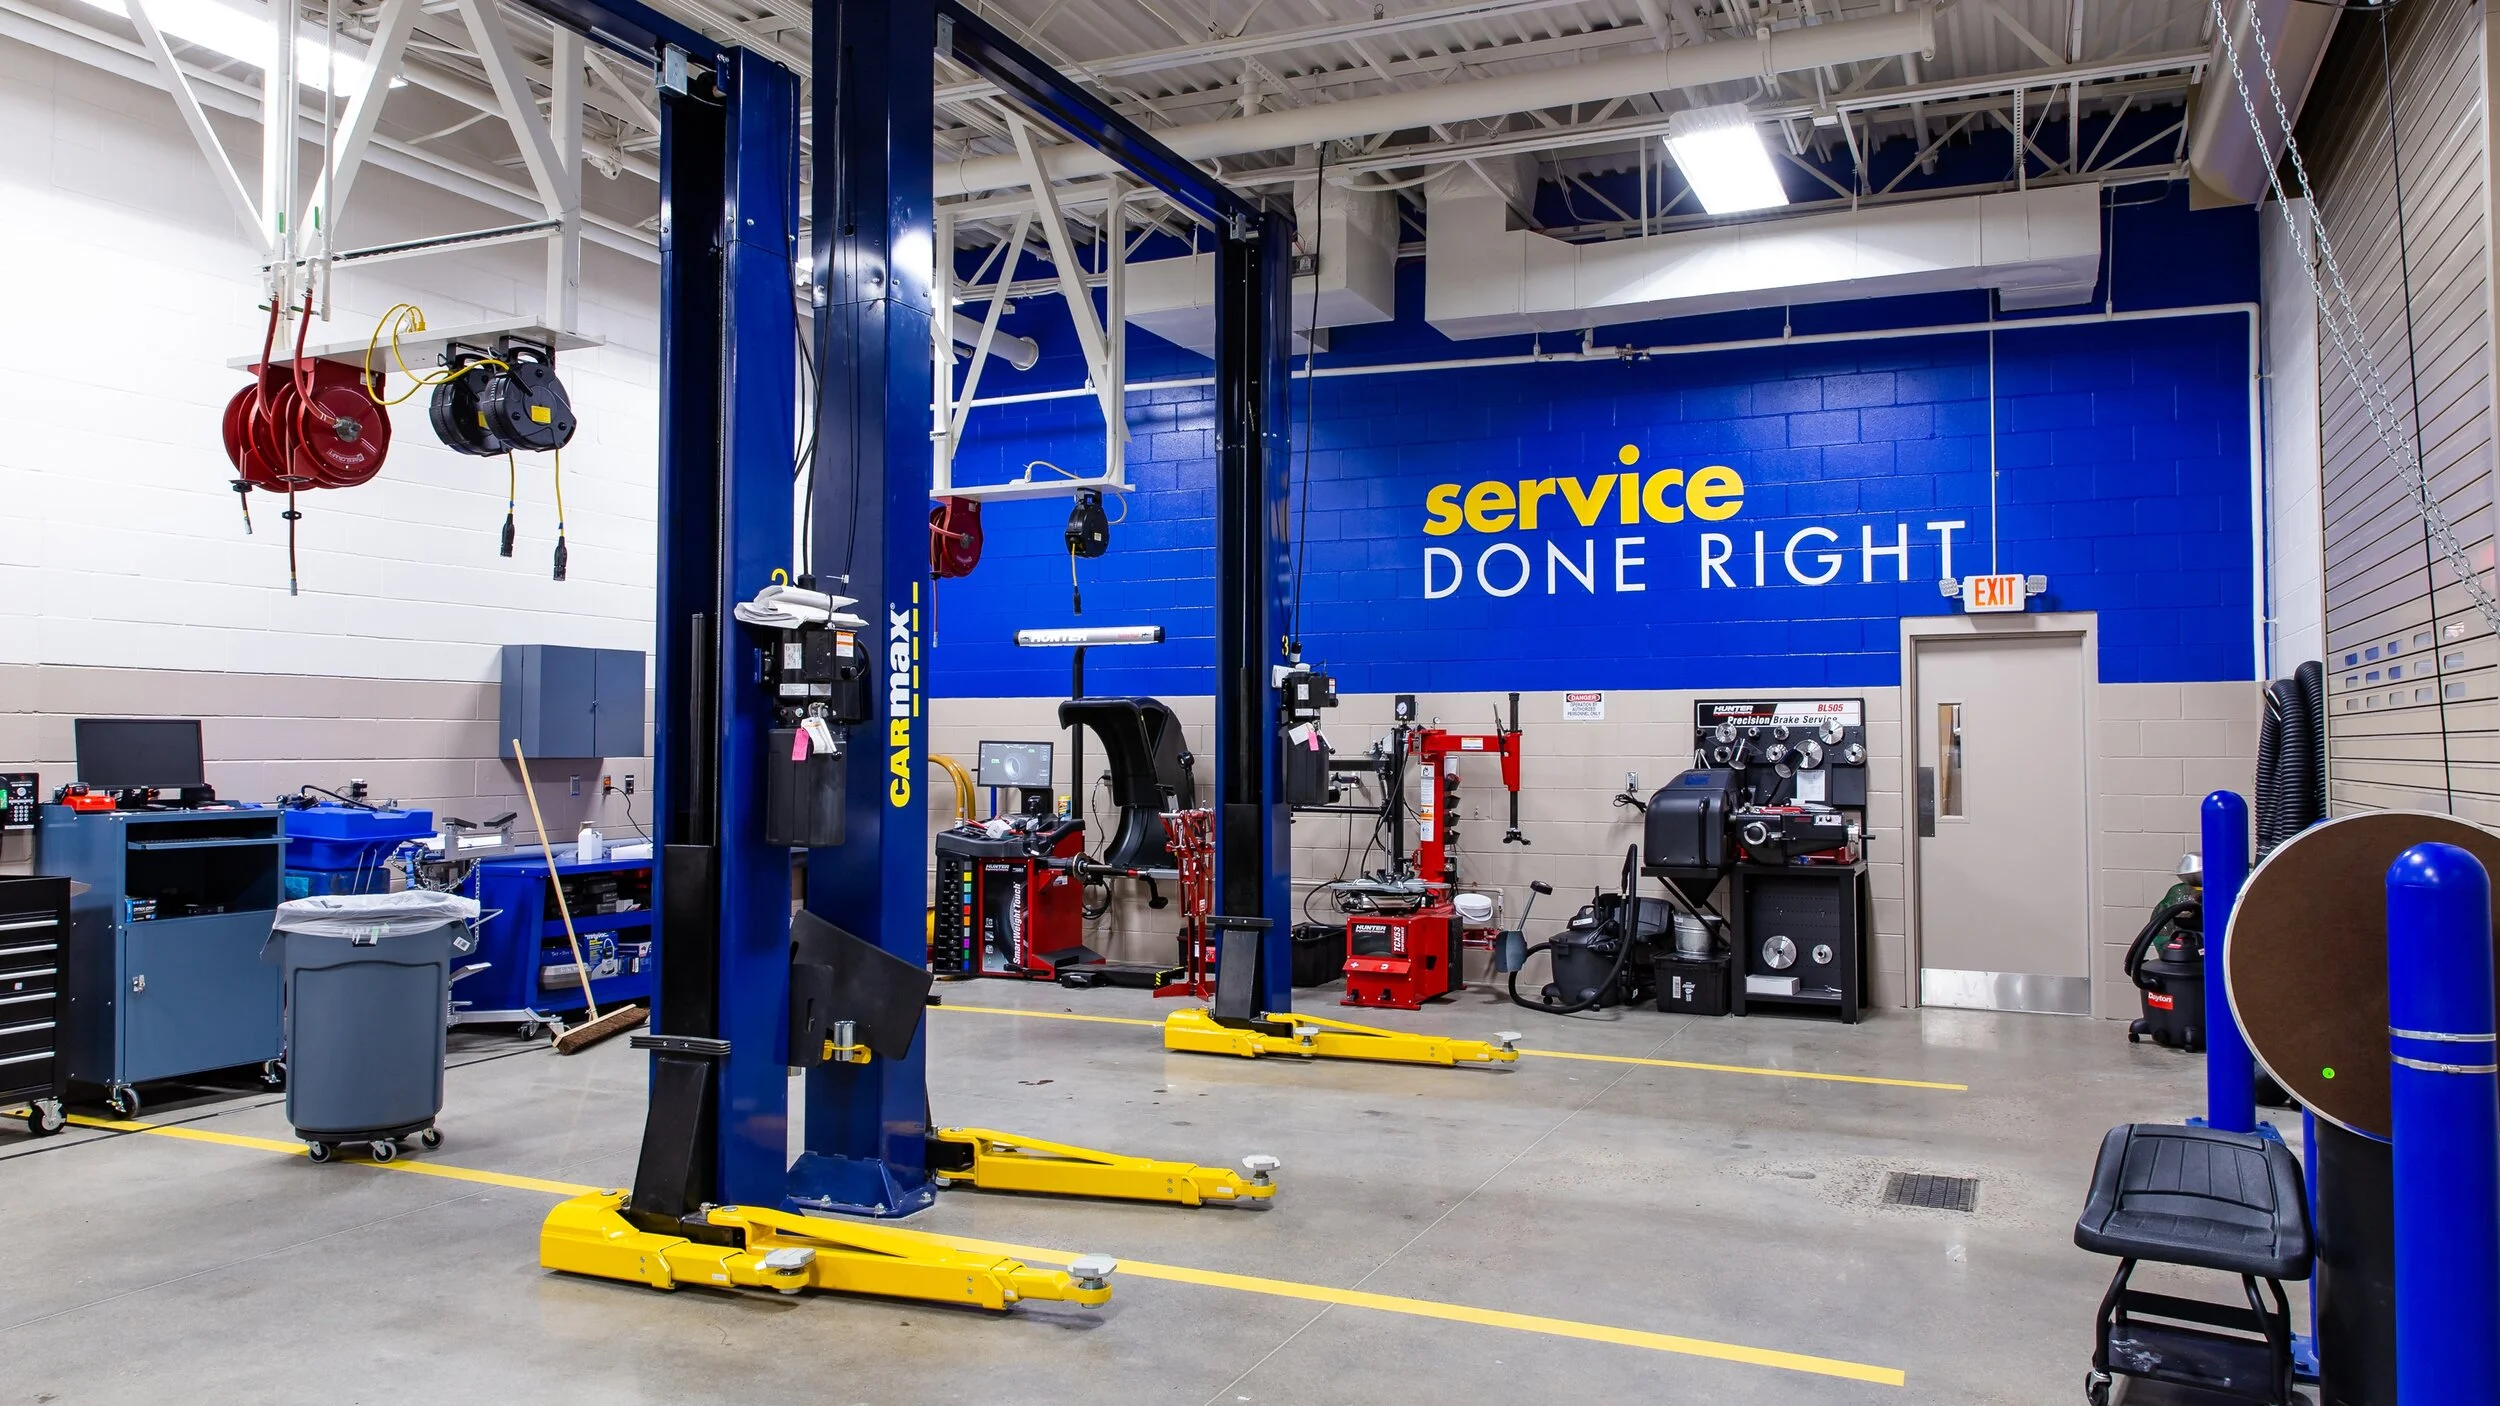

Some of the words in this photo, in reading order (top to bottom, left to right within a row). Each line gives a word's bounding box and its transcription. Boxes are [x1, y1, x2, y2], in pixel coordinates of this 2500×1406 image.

[1423, 444, 1745, 535] service
[1425, 537, 1646, 599] DONE
[1701, 520, 1966, 589] RIGHT
[1975, 577, 2016, 606] EXIT
[1282, 634, 1289, 656] 3
[889, 609, 911, 808] CARmax
[1727, 715, 1770, 725] Precision
[1773, 715, 1800, 724] Brake
[1817, 704, 1844, 712] BL505
[1013, 883, 1021, 908] Touch
[1013, 909, 1022, 965] SmartWeight
[2148, 992, 2172, 1003] Dayton
